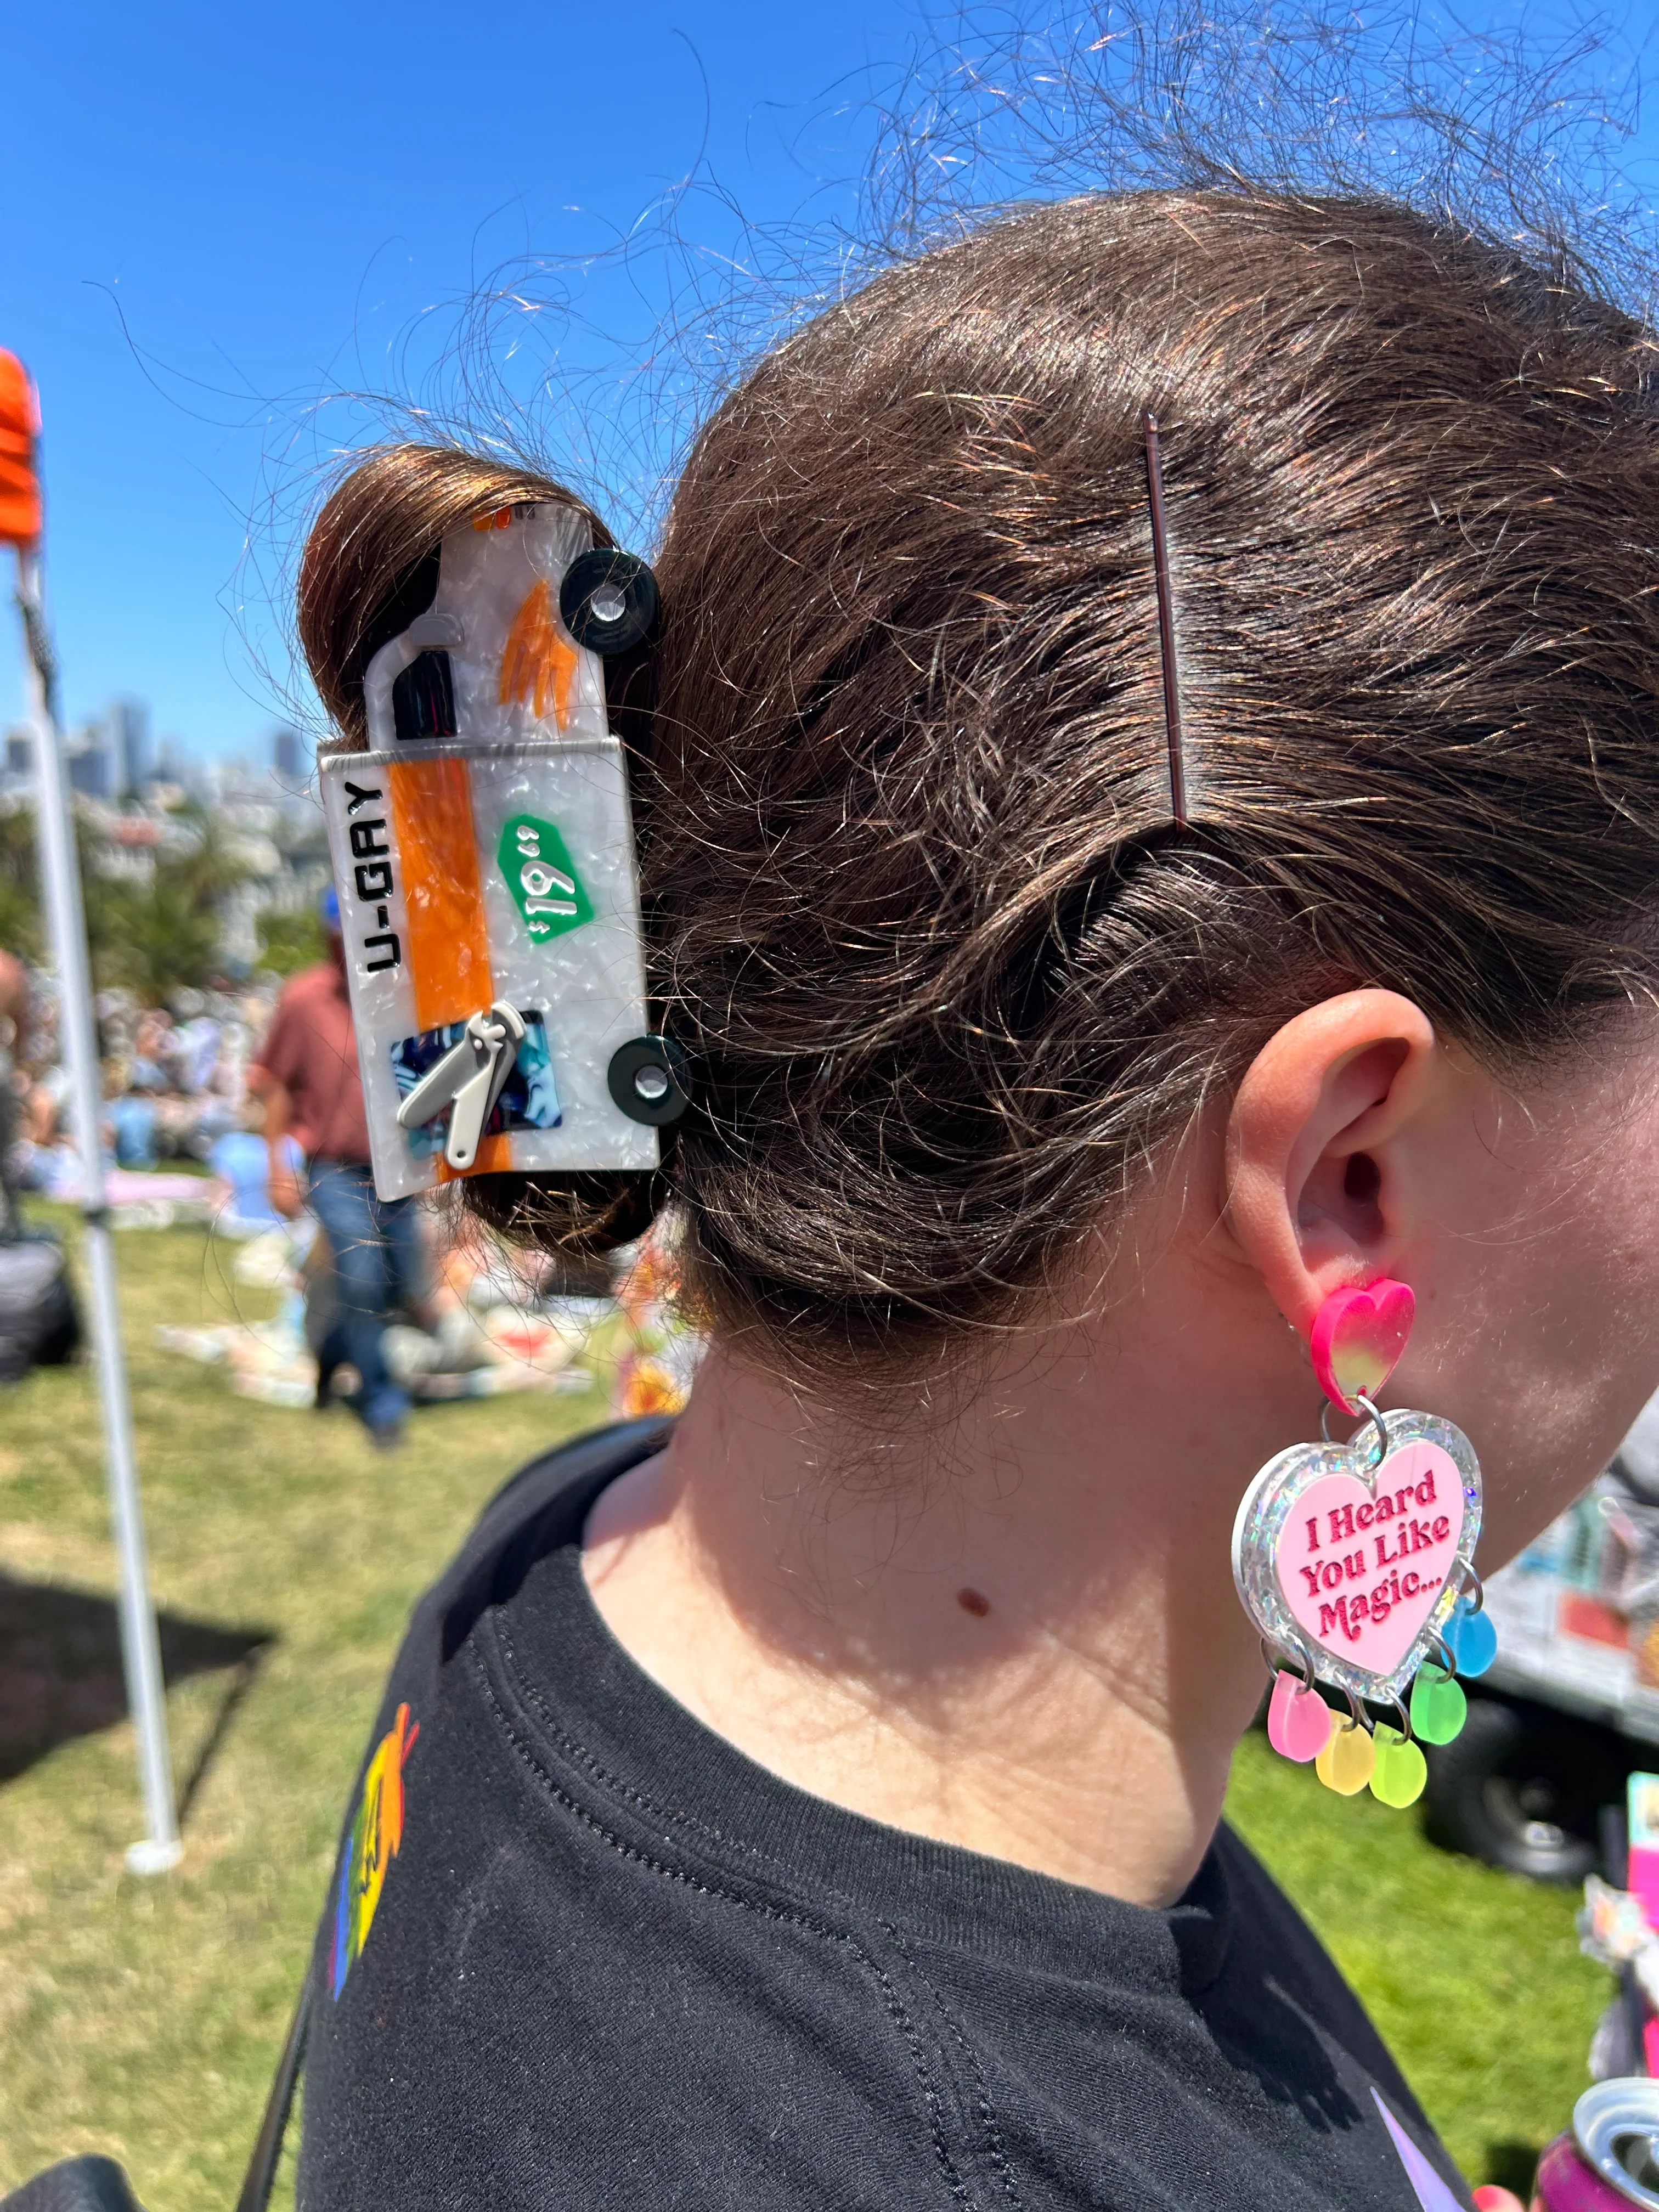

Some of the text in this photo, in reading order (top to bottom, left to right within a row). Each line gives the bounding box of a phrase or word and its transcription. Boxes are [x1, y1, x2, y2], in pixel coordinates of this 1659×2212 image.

[345, 782, 401, 972] U-GAY
[1306, 1470, 1437, 1551] I Heard
[1300, 1516, 1450, 1597] You Like
[1319, 1570, 1442, 1641] Magic...
